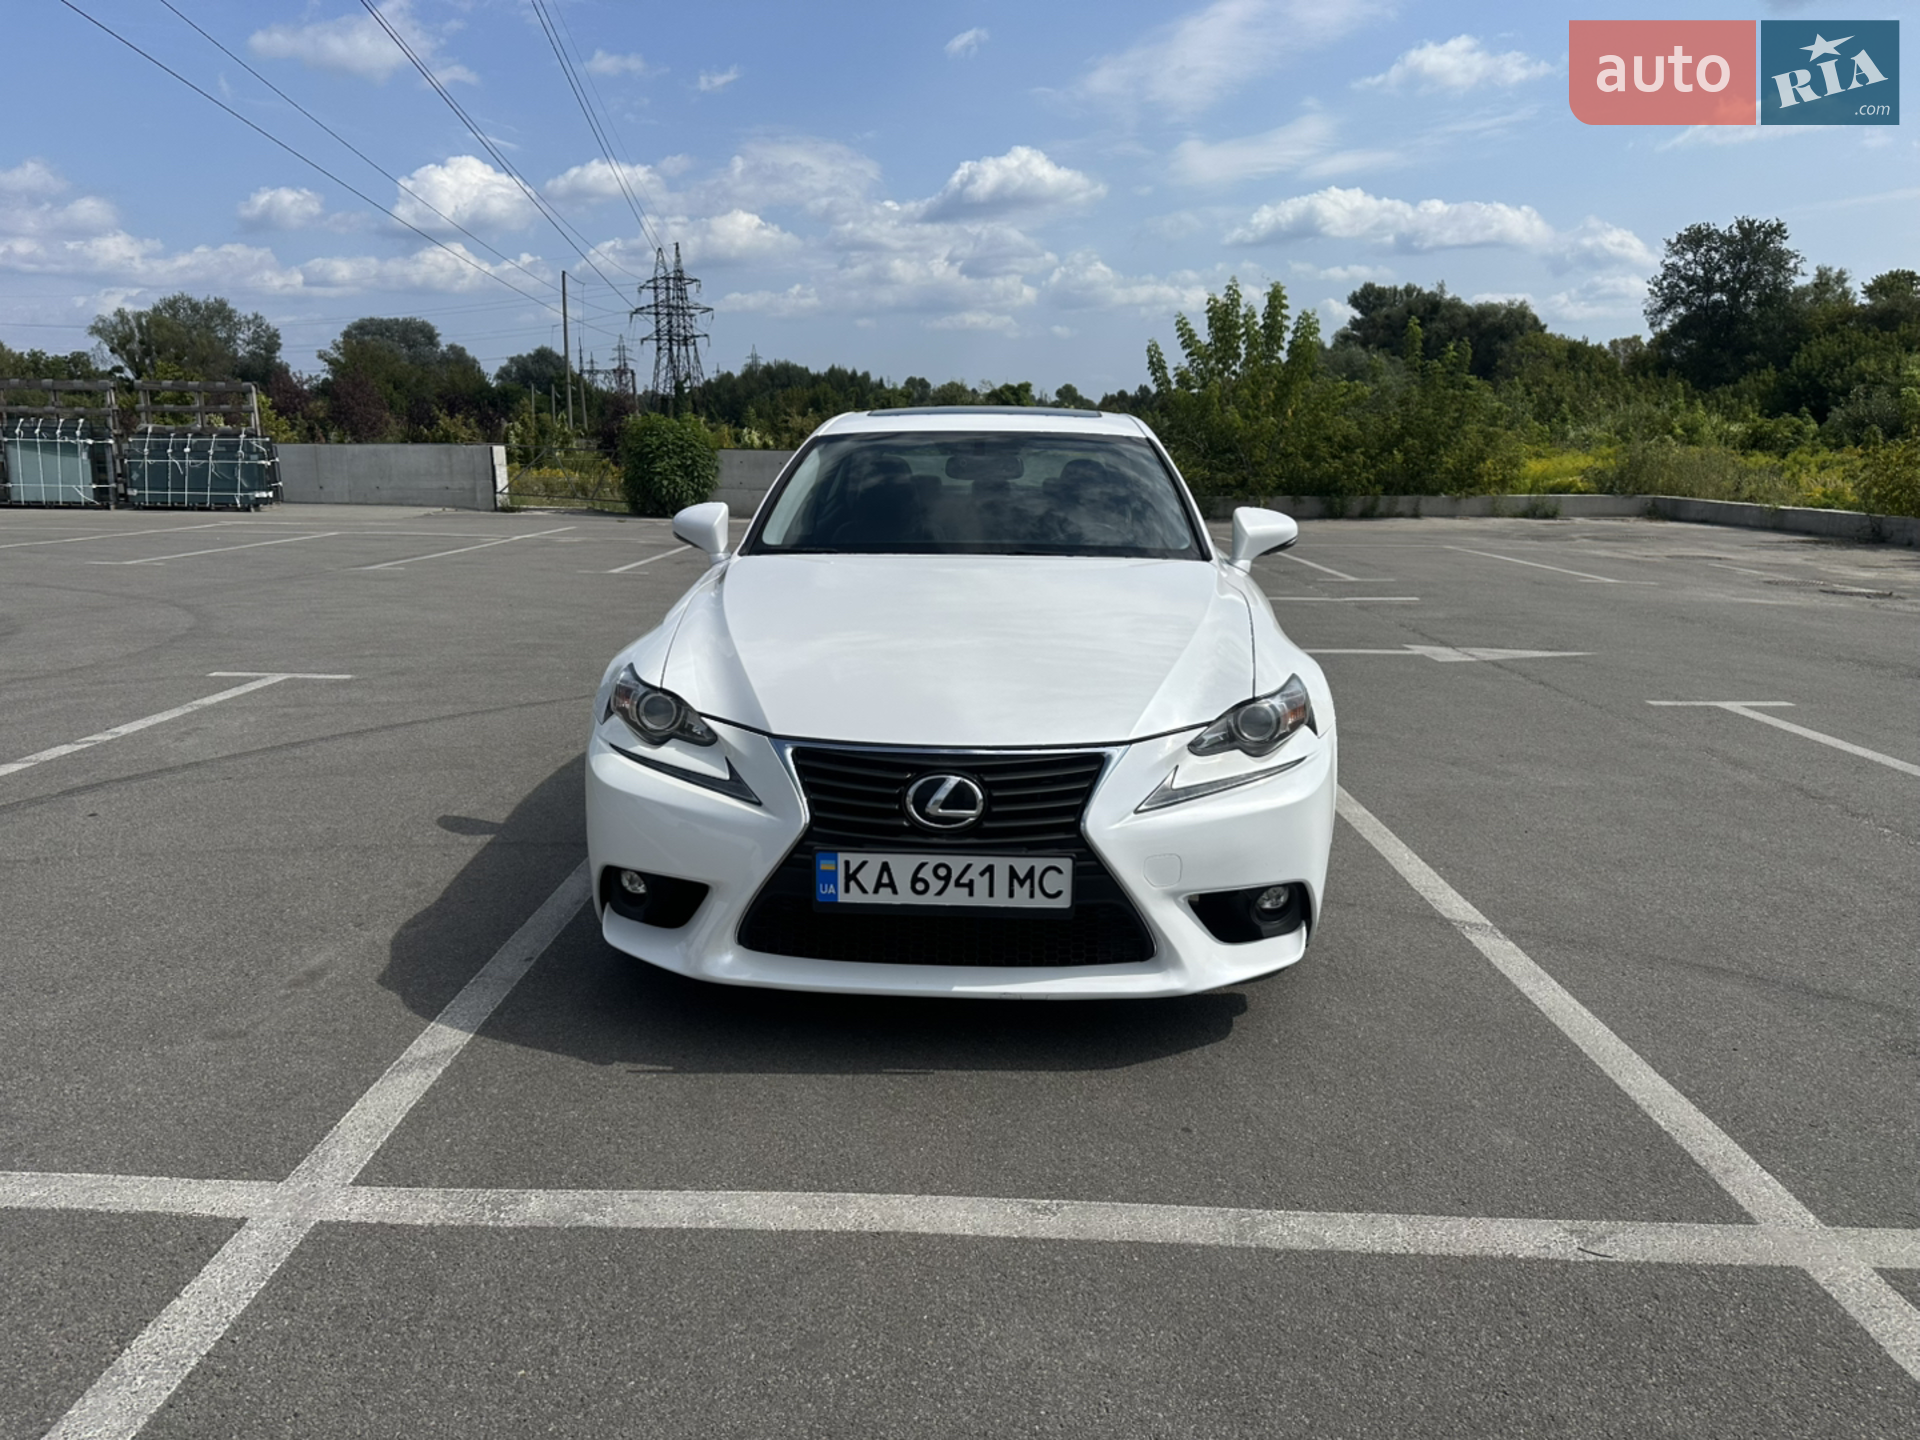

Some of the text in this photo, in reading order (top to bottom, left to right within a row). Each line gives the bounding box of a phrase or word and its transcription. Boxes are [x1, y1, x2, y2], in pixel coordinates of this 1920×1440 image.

[819, 883, 836, 894] UA
[843, 859, 1064, 899] KA 6941 MC
